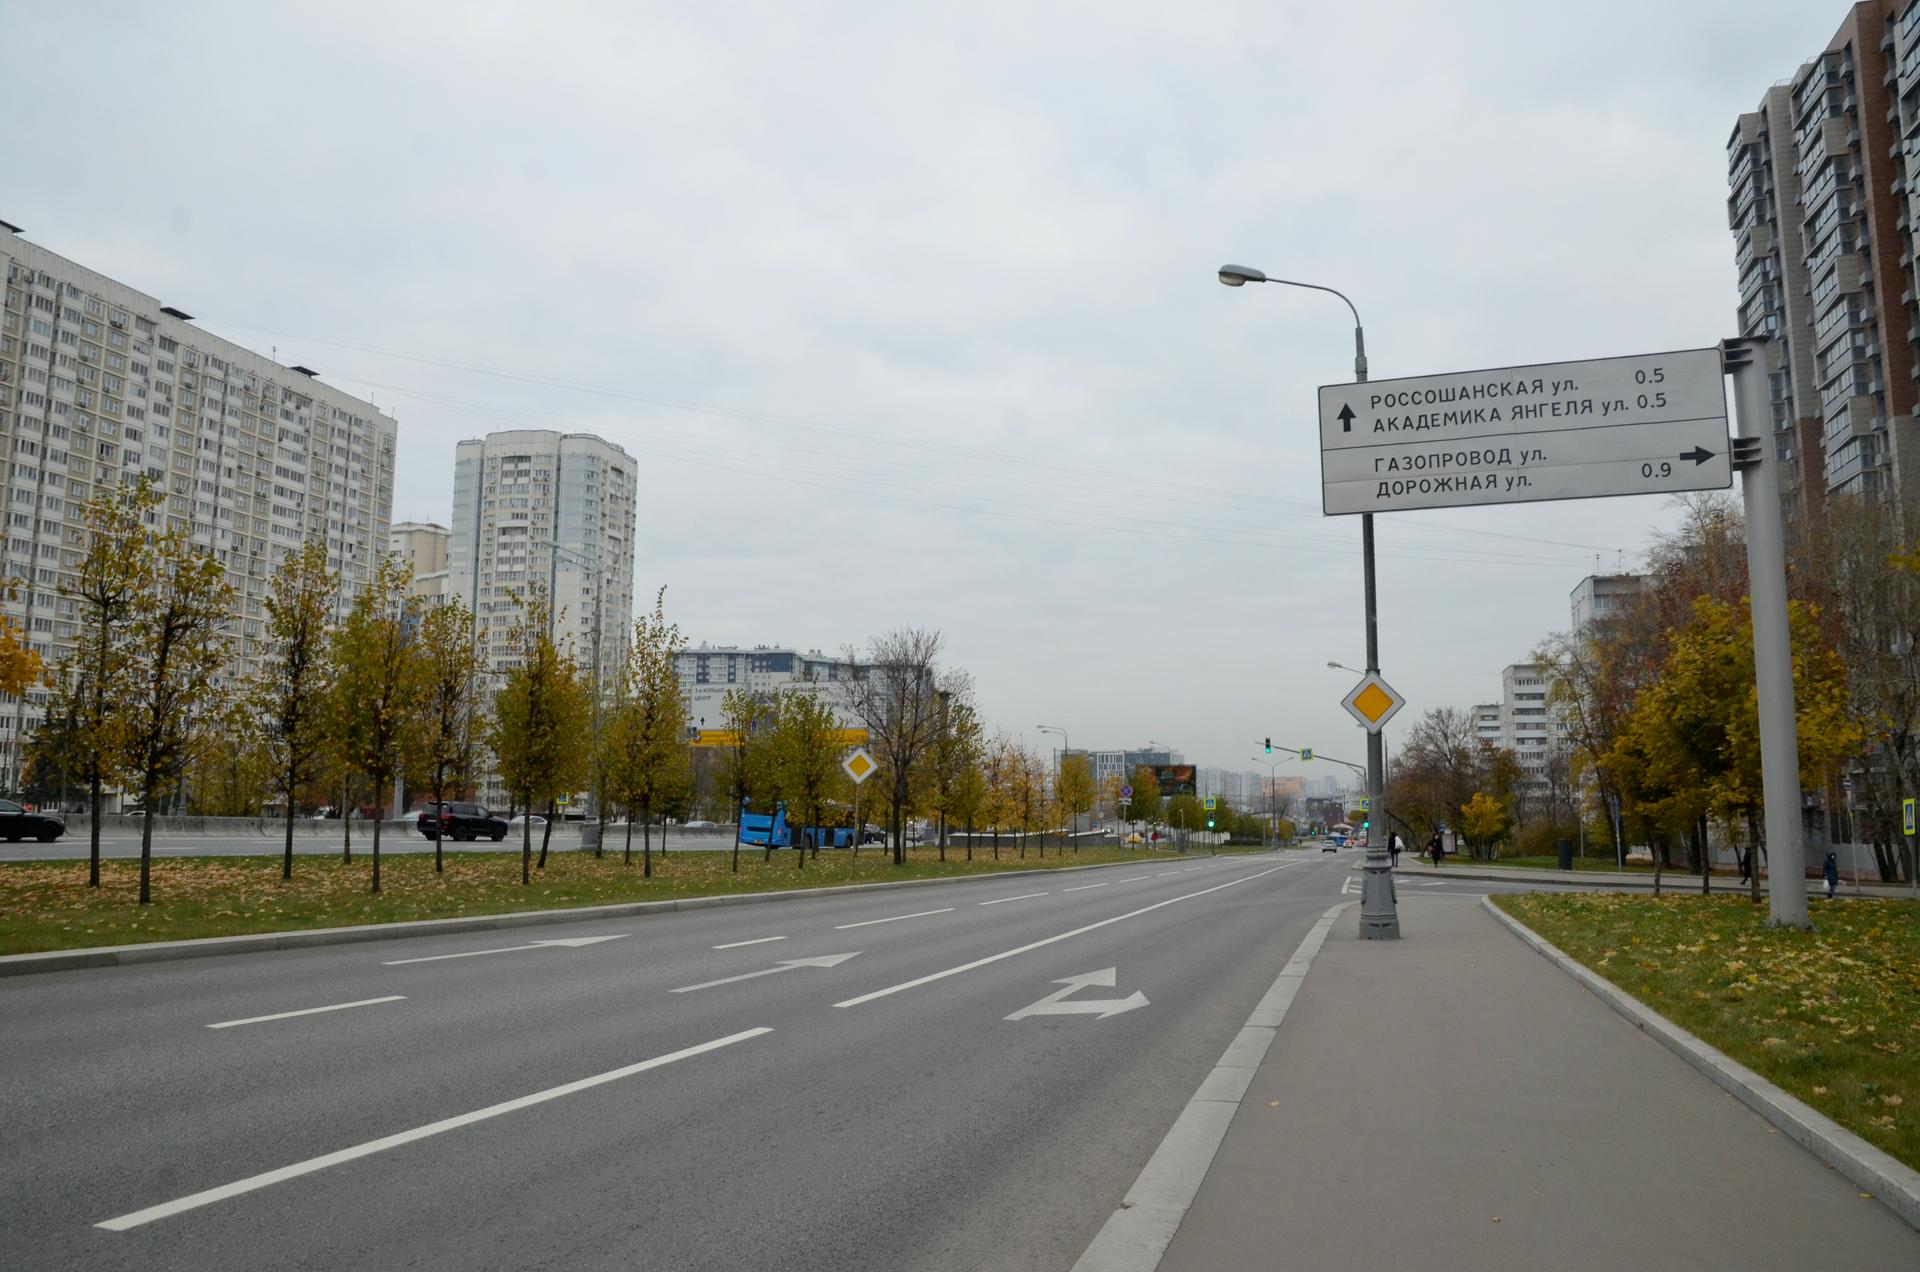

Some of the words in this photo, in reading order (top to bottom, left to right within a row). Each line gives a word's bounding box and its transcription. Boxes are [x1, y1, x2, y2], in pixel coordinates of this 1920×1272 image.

[1371, 379, 1543, 409] РОССОШАНСКАЯ
[1552, 380, 1579, 396] ул.
[1635, 368, 1664, 385] 0.5
[1373, 408, 1502, 433] АКАДЕМИКА
[1511, 399, 1593, 420] ЯНГЕЛЯ
[1601, 400, 1630, 416] ул.
[1637, 392, 1667, 409] 0.5
[1374, 448, 1512, 473] ГАЗОПРОВОД
[1520, 449, 1547, 466] ул.
[1376, 474, 1498, 498] ДОРОЖНАЯ
[1505, 475, 1532, 492] ул.
[1641, 462, 1671, 479] 0.9
